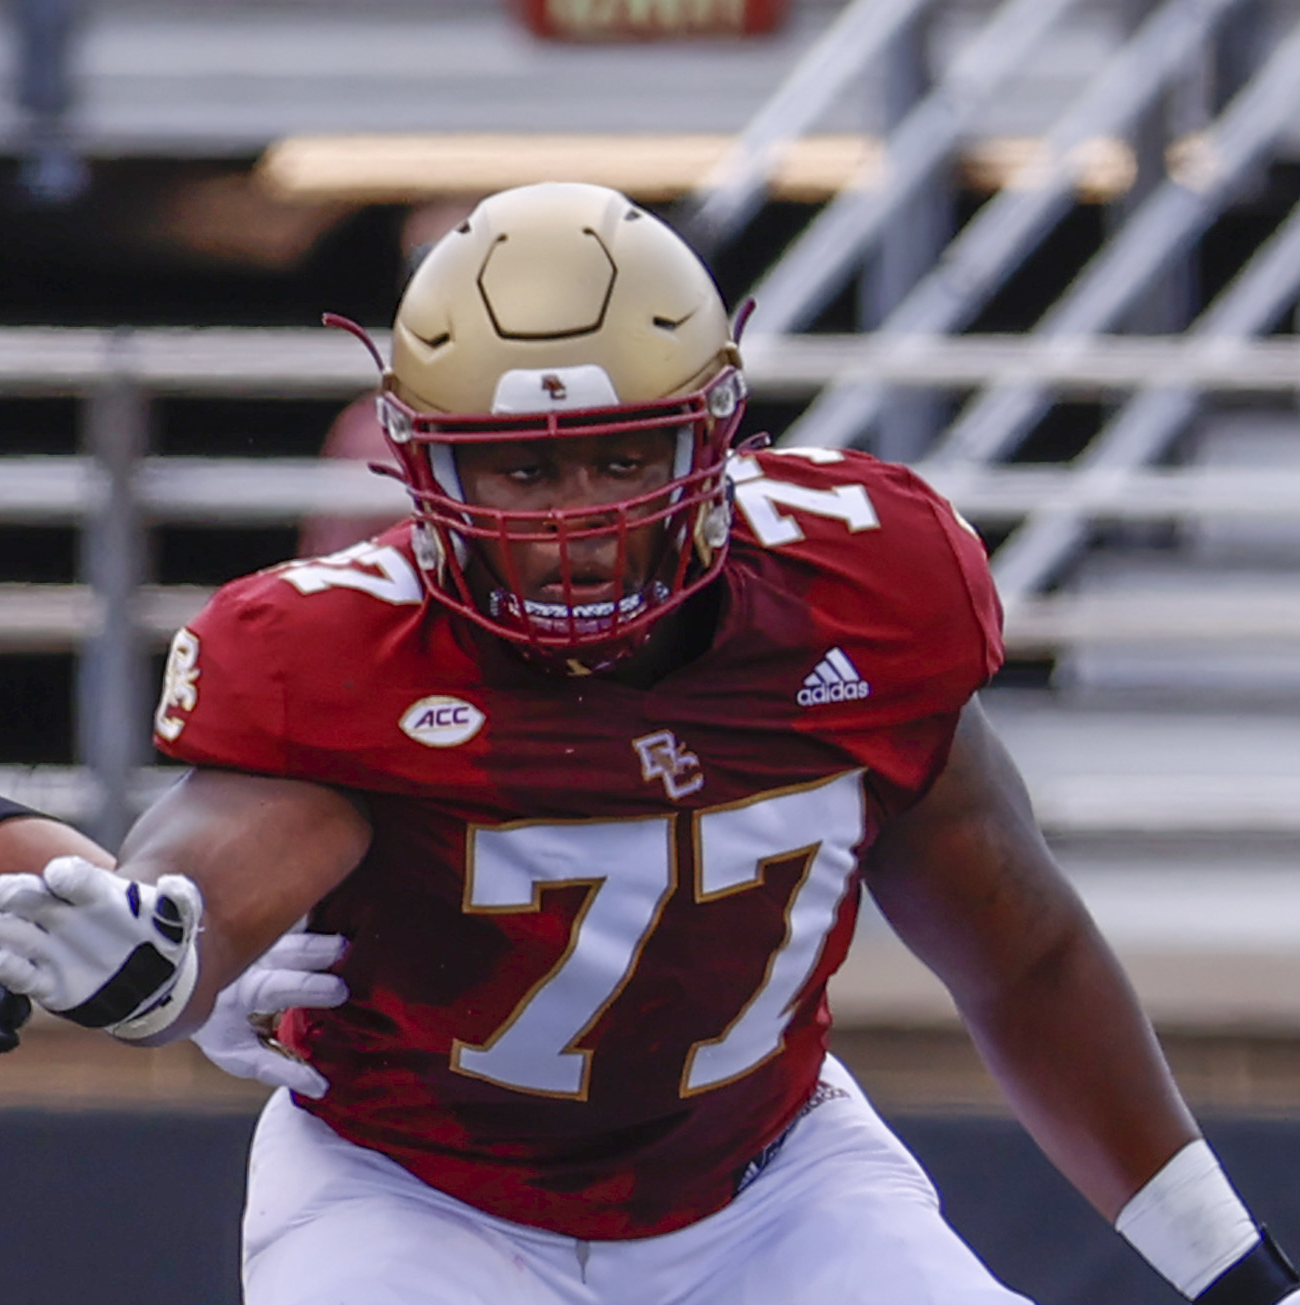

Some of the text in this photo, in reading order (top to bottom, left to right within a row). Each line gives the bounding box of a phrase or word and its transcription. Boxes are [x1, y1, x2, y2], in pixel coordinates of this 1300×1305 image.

[796, 680, 870, 706] adidas
[413, 706, 470, 729] ACC
[449, 767, 870, 1101] 77
